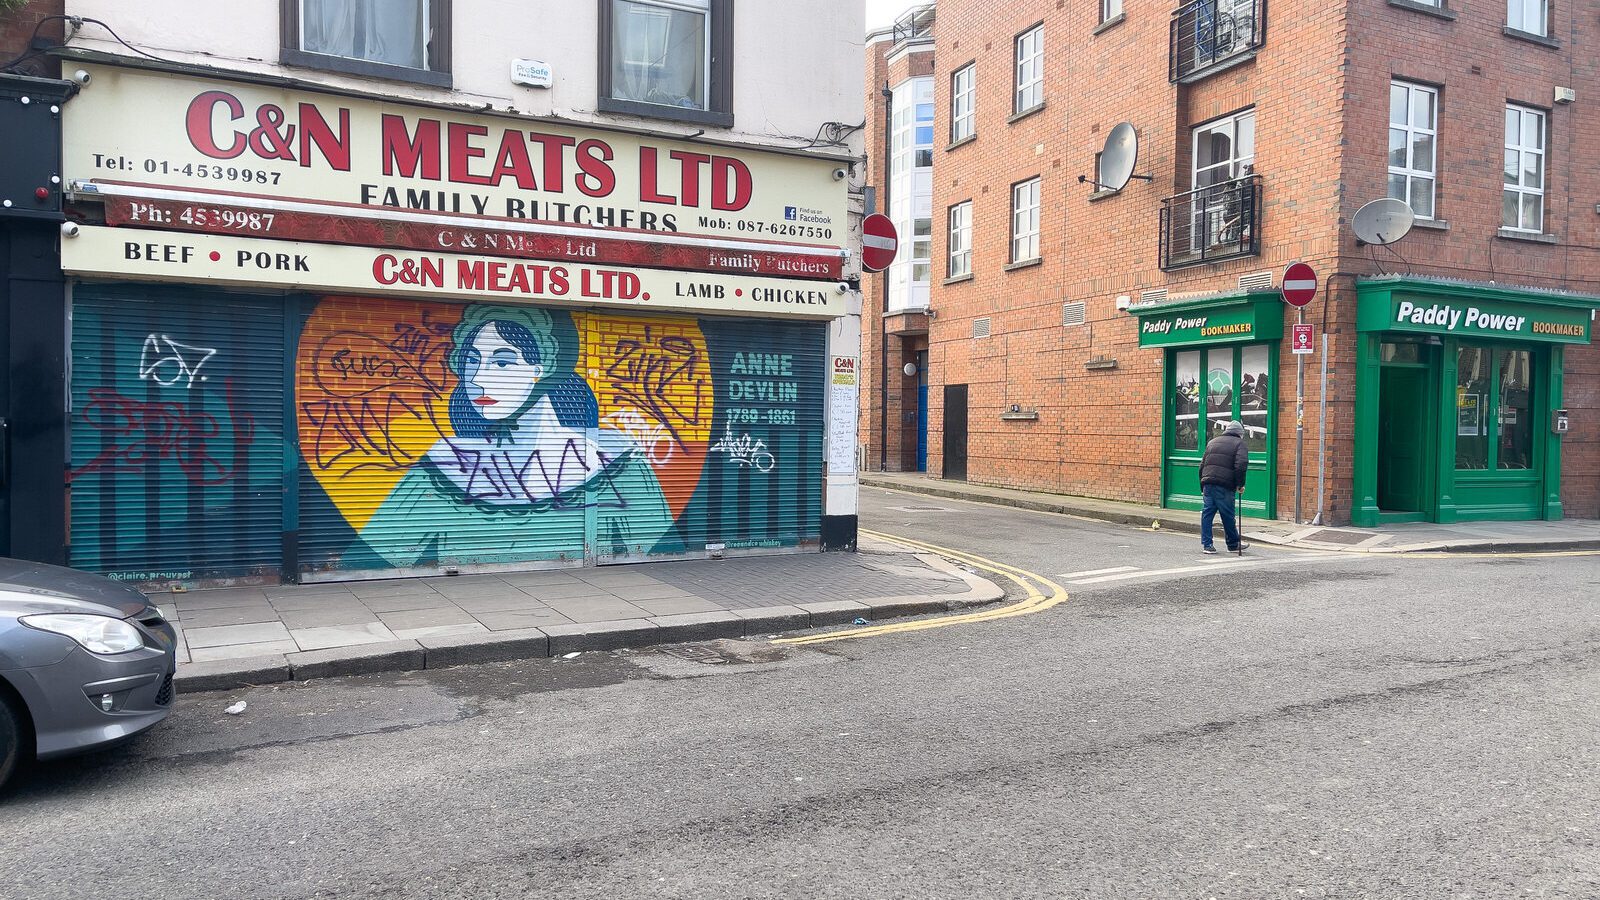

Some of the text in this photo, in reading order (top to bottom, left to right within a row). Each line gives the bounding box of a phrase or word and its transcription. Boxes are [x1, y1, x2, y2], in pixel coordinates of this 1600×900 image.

[516, 65, 549, 76] ProSafe
[185, 90, 752, 211] C&N MEATS LTD
[92, 153, 282, 185] Tel: 01-4539987
[130, 202, 275, 231] Ph: 4539987
[698, 216, 832, 239] Mob: 087-6267550
[800, 214, 832, 224] Facebook
[437, 231, 453, 247] C
[460, 232, 477, 248] &
[484, 234, 499, 249] N
[566, 240, 597, 257] Ltd
[124, 242, 311, 272] BEEF PORK
[709, 253, 762, 271] Family
[372, 253, 650, 302] C&N MEATS LTD.
[675, 282, 828, 305] LAMB CHICKEN
[1142, 317, 1207, 334] Paddy Power
[1201, 323, 1252, 336] BOOKMAKER
[1397, 301, 1585, 336] Paddy Power BOOKMAKER
[730, 352, 793, 376] ANNE
[834, 357, 854, 368] C&N
[729, 380, 798, 402] DEVLIN
